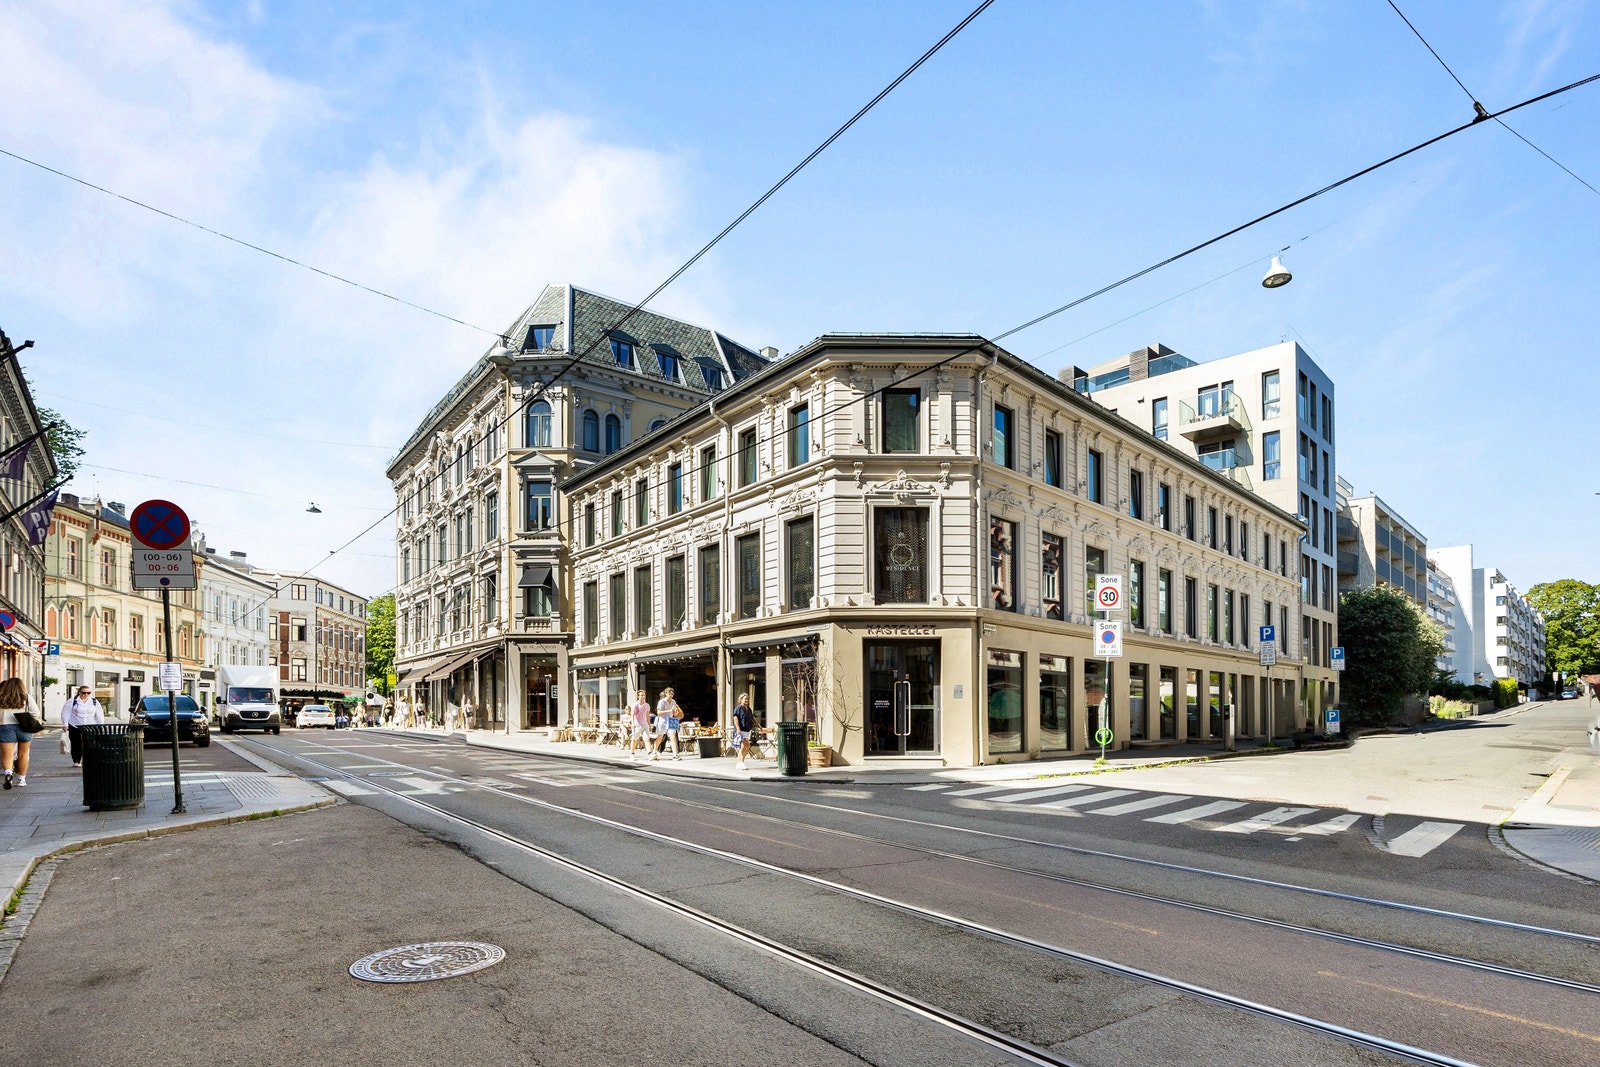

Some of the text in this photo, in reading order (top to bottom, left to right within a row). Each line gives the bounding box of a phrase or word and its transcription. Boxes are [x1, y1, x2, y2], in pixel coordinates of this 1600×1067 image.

[1100, 576, 1118, 584] Sone
[1102, 591, 1116, 602] 30
[866, 624, 937, 636] KASTELLET
[1263, 628, 1271, 639] P
[1334, 649, 1341, 658] P
[1329, 712, 1336, 720] P
